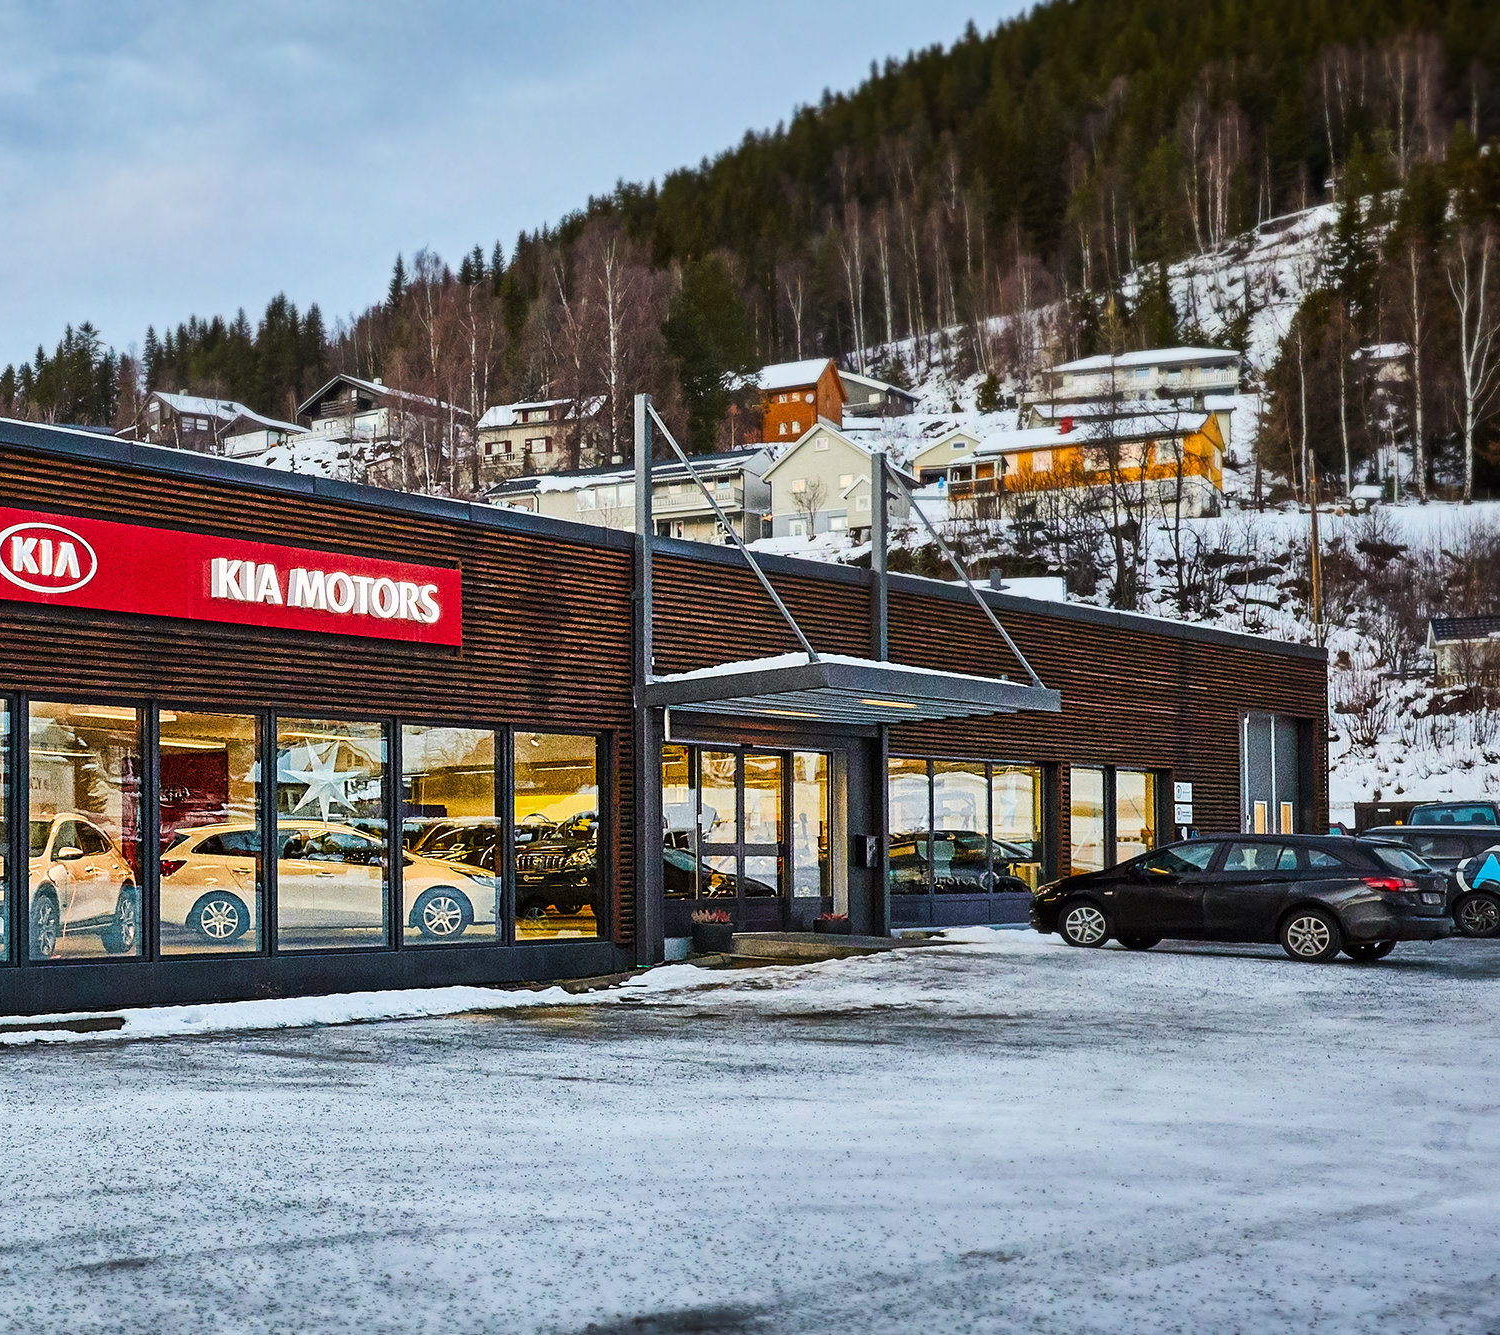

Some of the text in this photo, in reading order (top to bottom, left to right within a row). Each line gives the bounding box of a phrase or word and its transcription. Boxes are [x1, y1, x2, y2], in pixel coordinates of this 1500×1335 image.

[11, 536, 81, 579] KIA
[211, 557, 441, 624] KIA MOTORS
